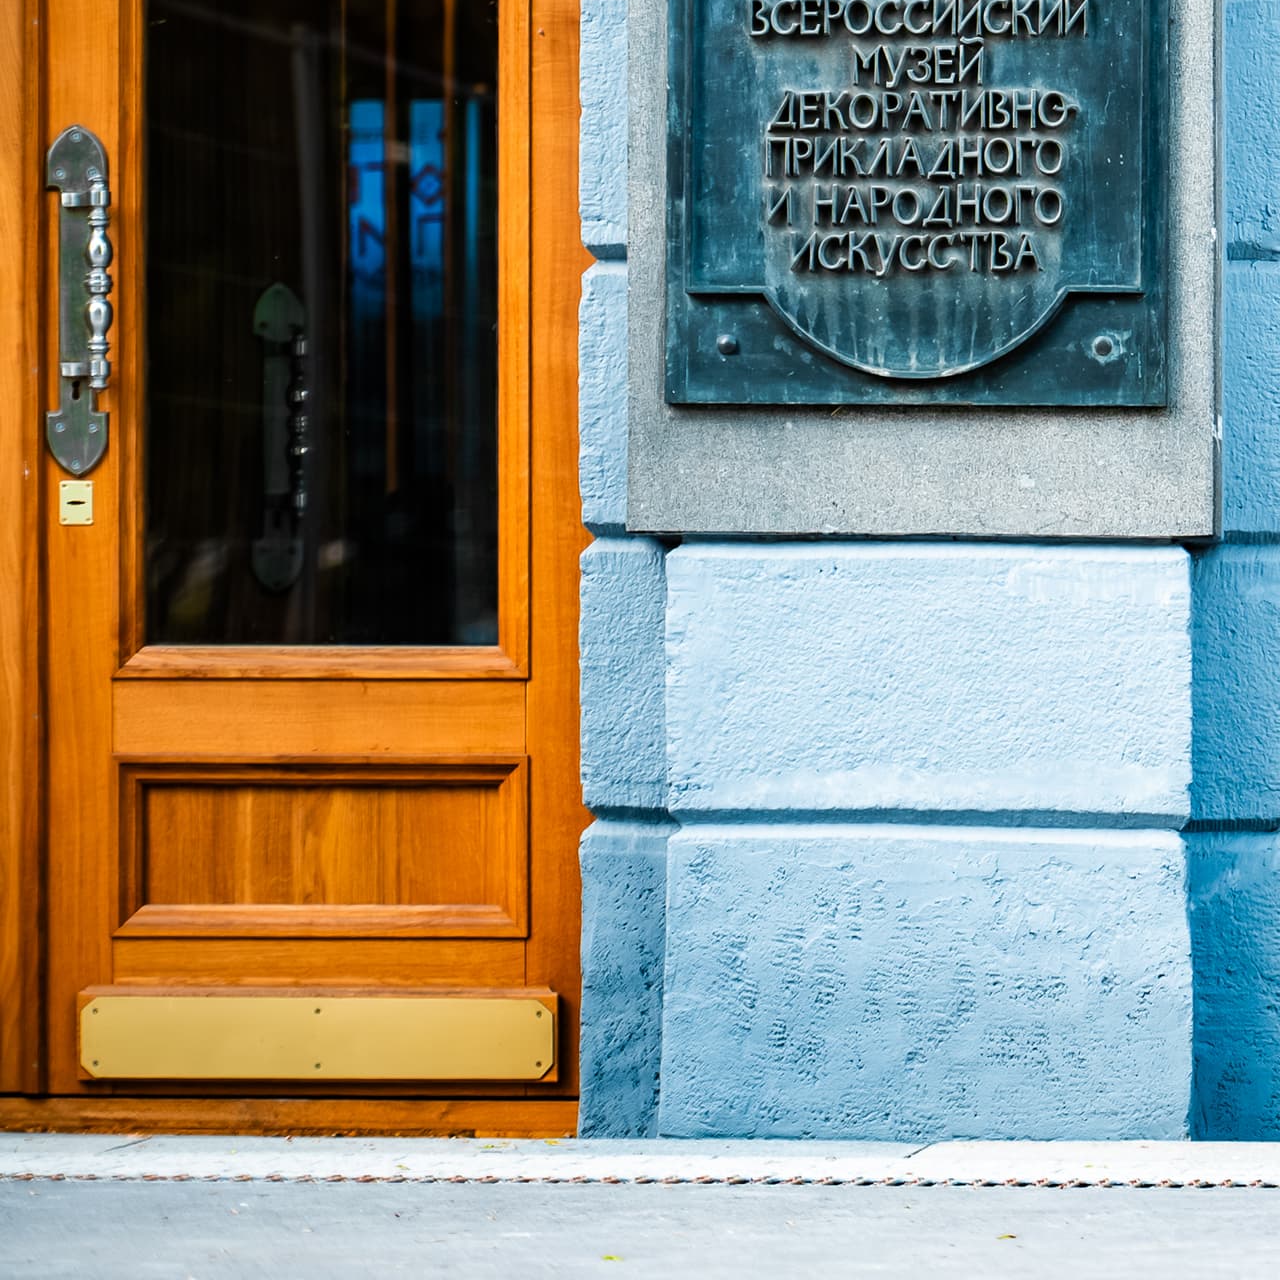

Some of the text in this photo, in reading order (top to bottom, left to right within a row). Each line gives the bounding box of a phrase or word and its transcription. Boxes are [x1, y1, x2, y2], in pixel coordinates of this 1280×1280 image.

[853, 37, 985, 88] МУЗЕЙ
[765, 136, 1063, 180] ПРИКЛАДНОГО
[767, 184, 1063, 228] И НАРОДНОГО
[790, 231, 1045, 276] ИСКУССТВА
